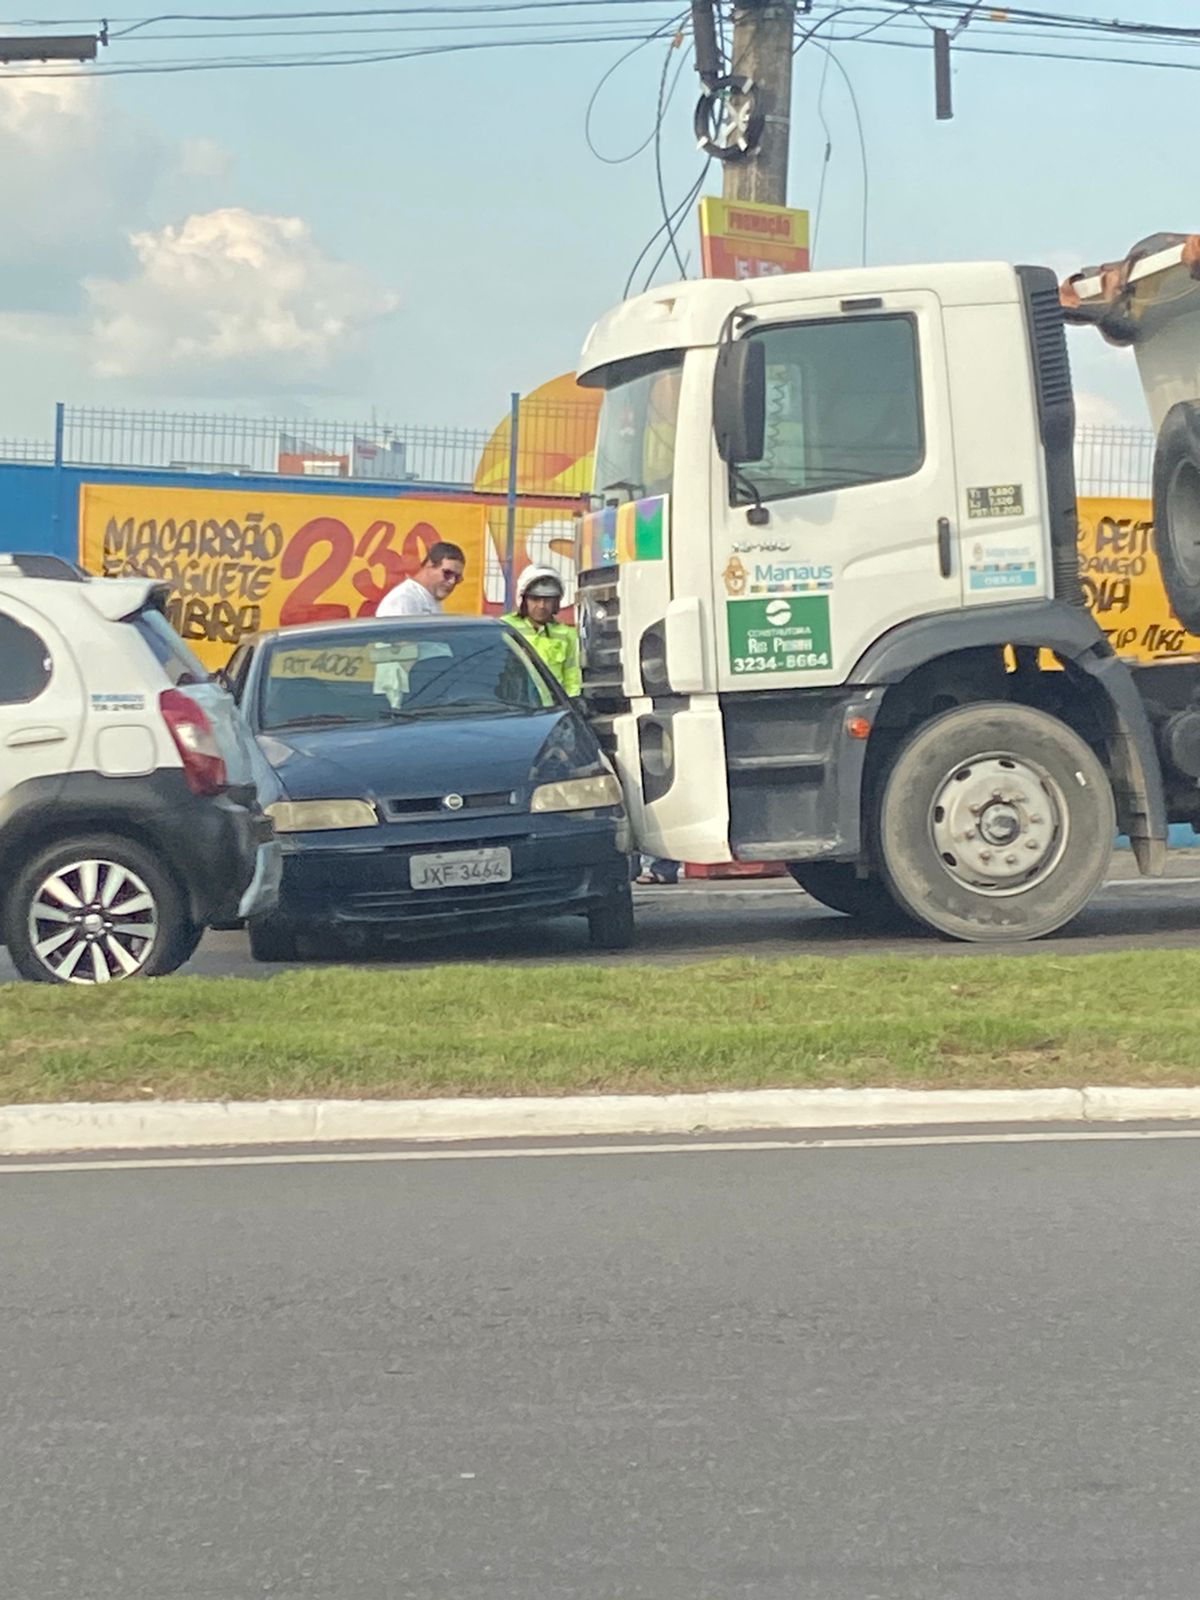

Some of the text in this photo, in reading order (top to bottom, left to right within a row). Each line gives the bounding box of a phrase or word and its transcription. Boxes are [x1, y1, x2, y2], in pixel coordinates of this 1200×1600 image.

[104, 512, 284, 561] MACARRÃO
[1096, 515, 1156, 554] PEIT
[754, 564, 832, 582] Manaus
[418, 865, 454, 885] JXF
